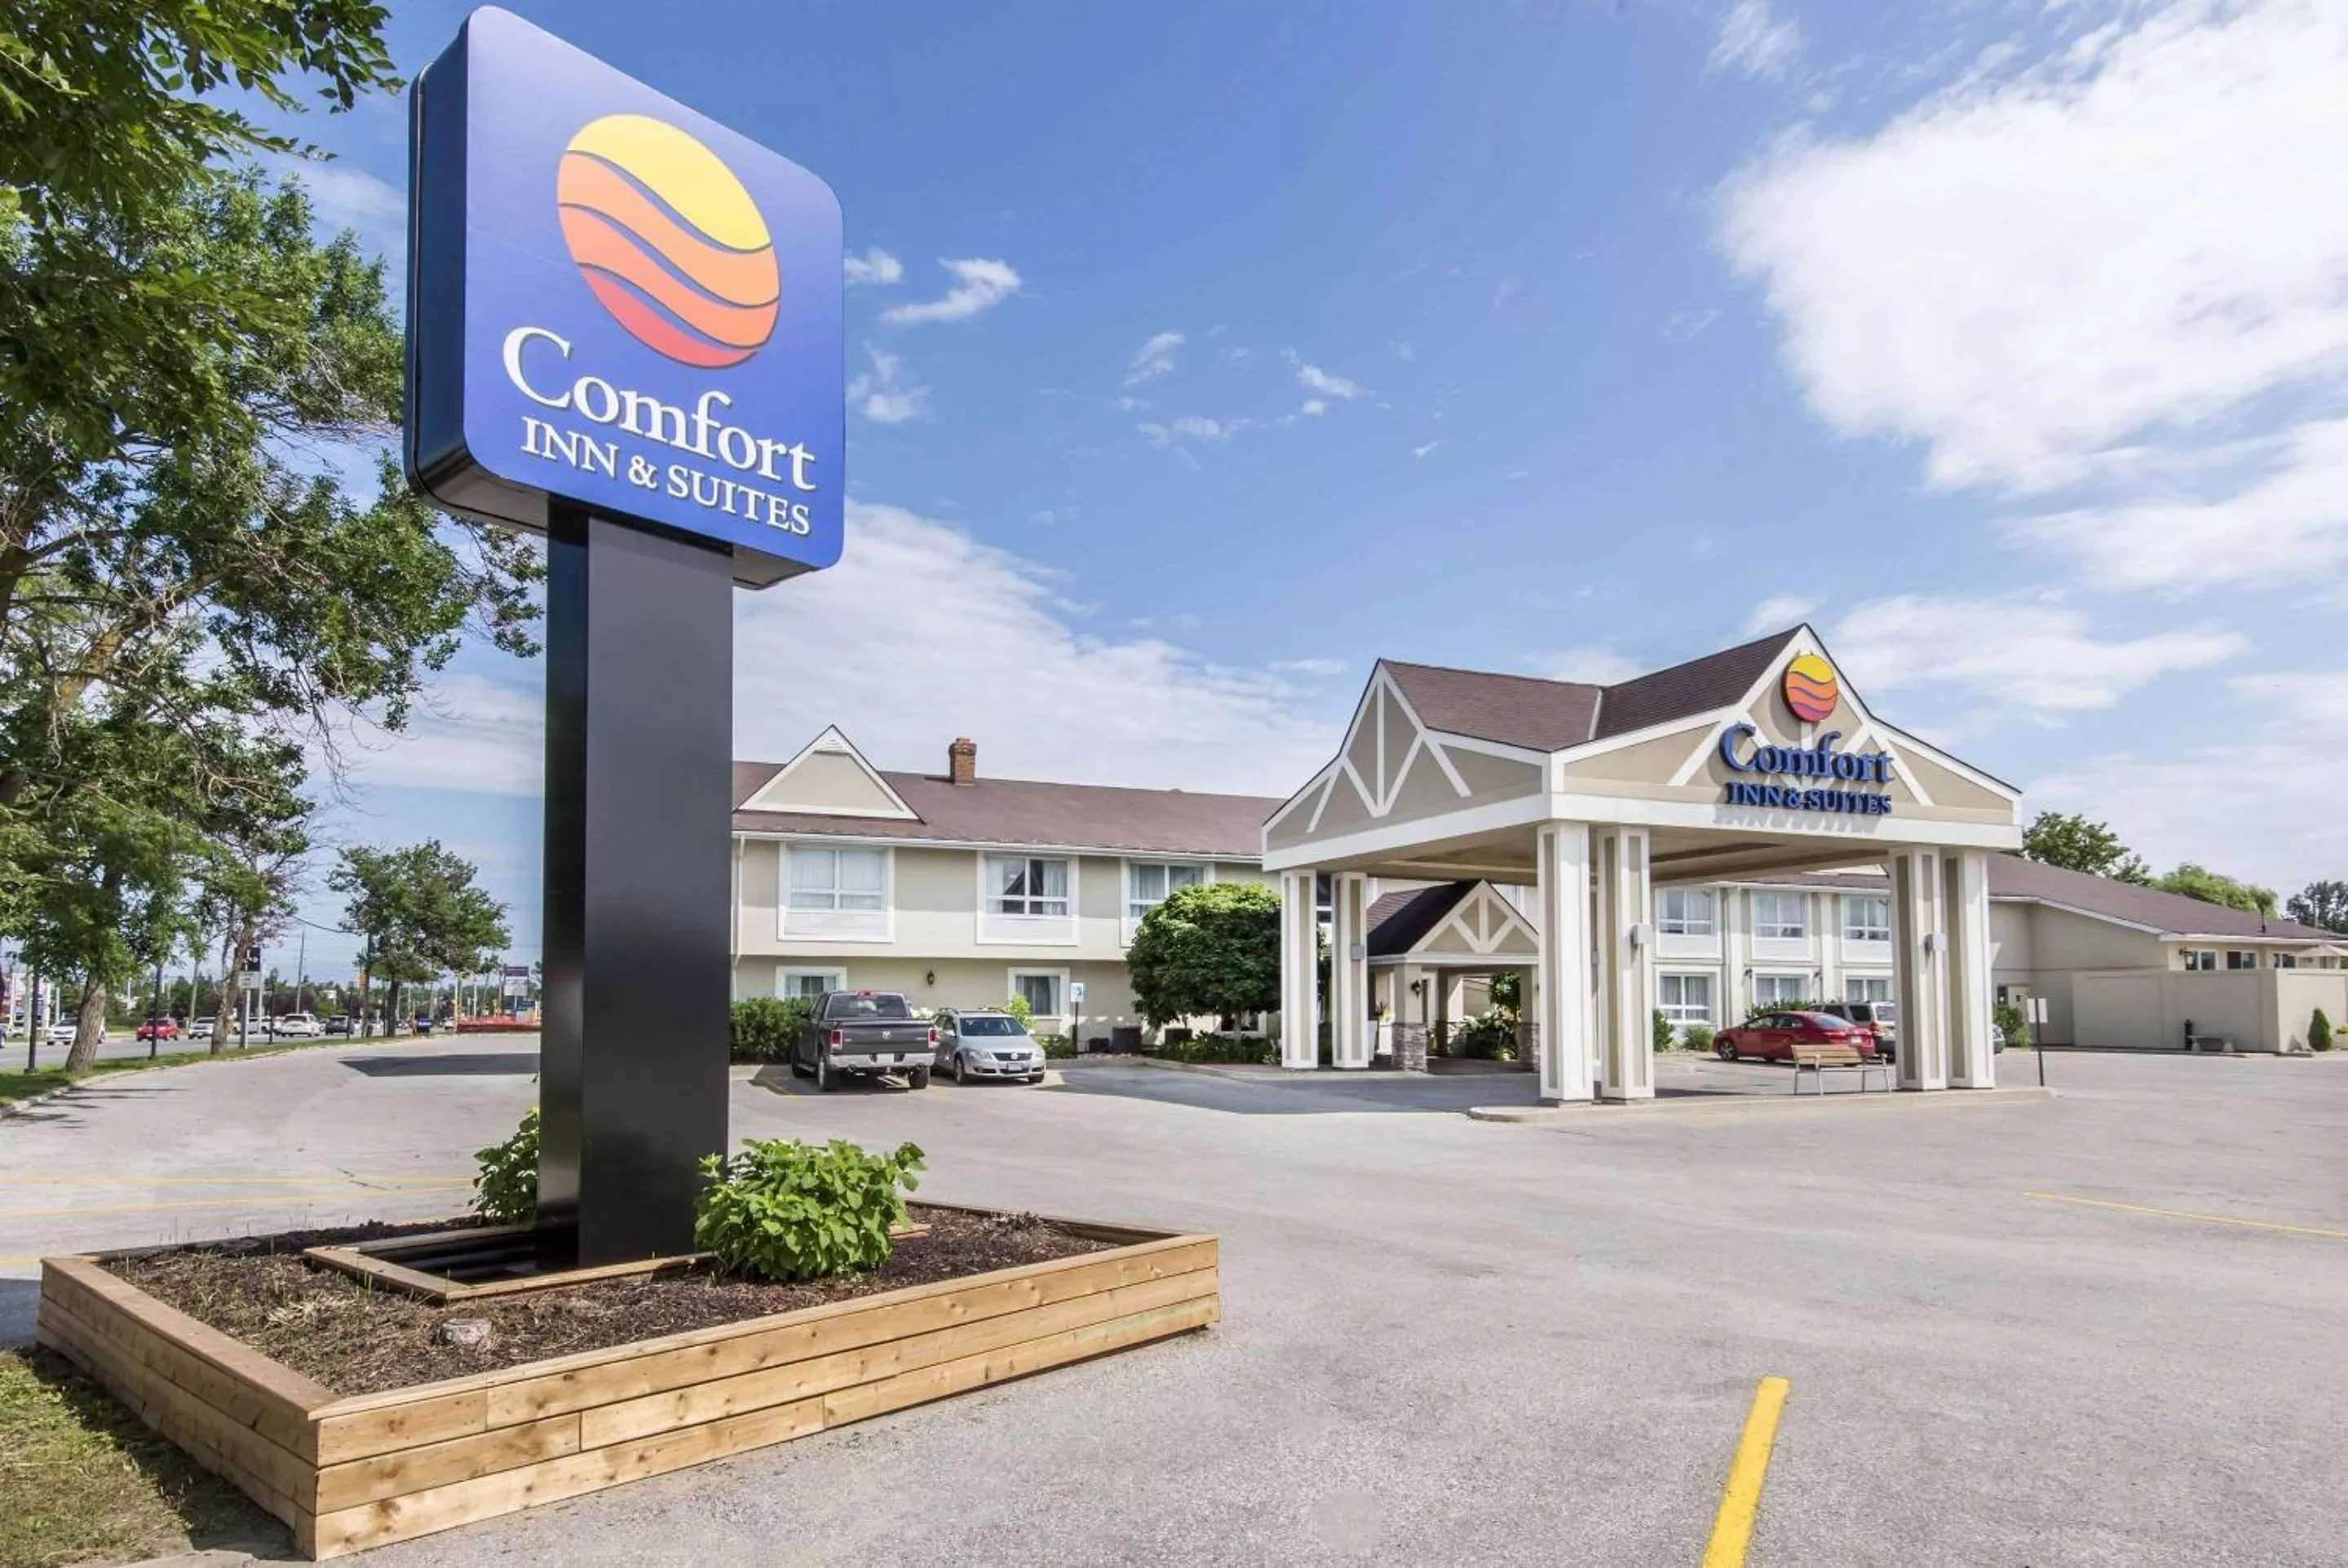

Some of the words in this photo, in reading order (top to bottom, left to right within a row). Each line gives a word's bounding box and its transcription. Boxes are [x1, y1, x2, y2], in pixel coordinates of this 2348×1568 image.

[502, 325, 816, 491] Comfort
[520, 416, 619, 479] INN
[627, 453, 657, 489] &
[666, 464, 813, 537] SUITES
[1719, 723, 1895, 783] Comfort
[1727, 782, 1784, 806] INN
[1805, 789, 1892, 815] SUITES
